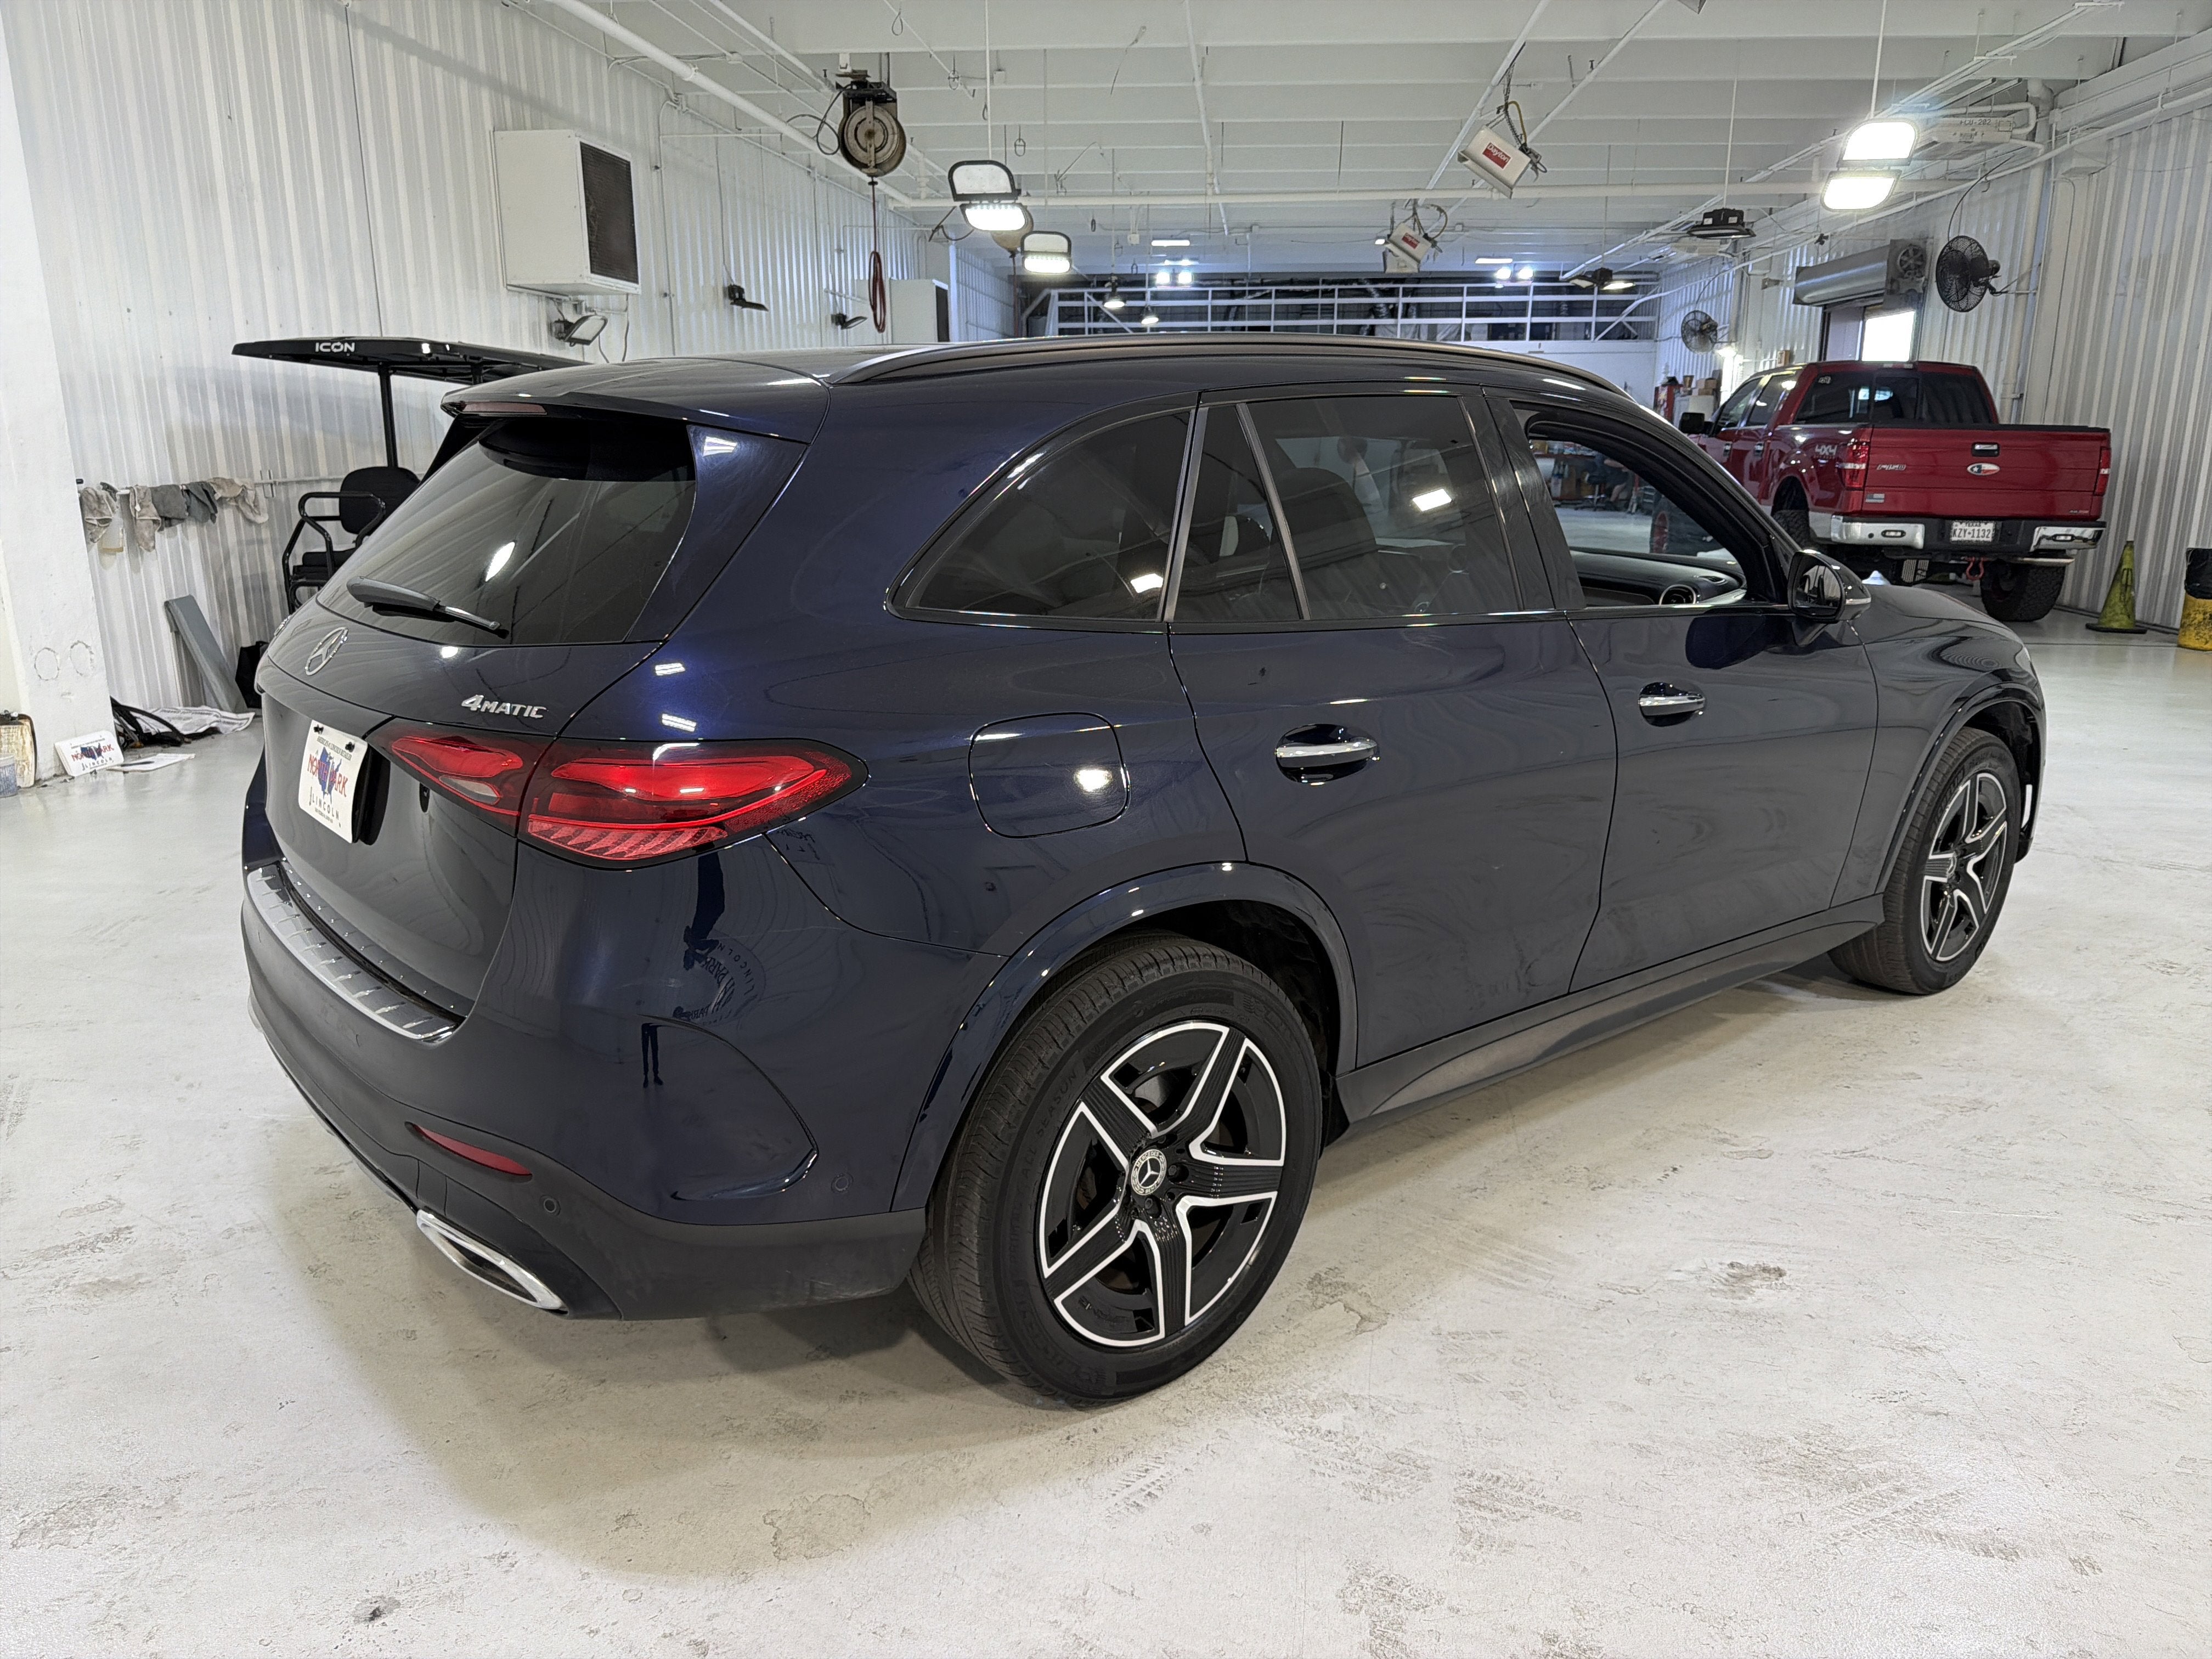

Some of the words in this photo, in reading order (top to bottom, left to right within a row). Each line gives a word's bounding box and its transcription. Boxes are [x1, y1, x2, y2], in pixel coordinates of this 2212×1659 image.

[1487, 144, 1509, 162] Dayton
[315, 341, 356, 352] ICON
[461, 694, 548, 719] 4MATIC
[329, 768, 348, 797] PARK
[312, 793, 339, 820] LINCOLN
